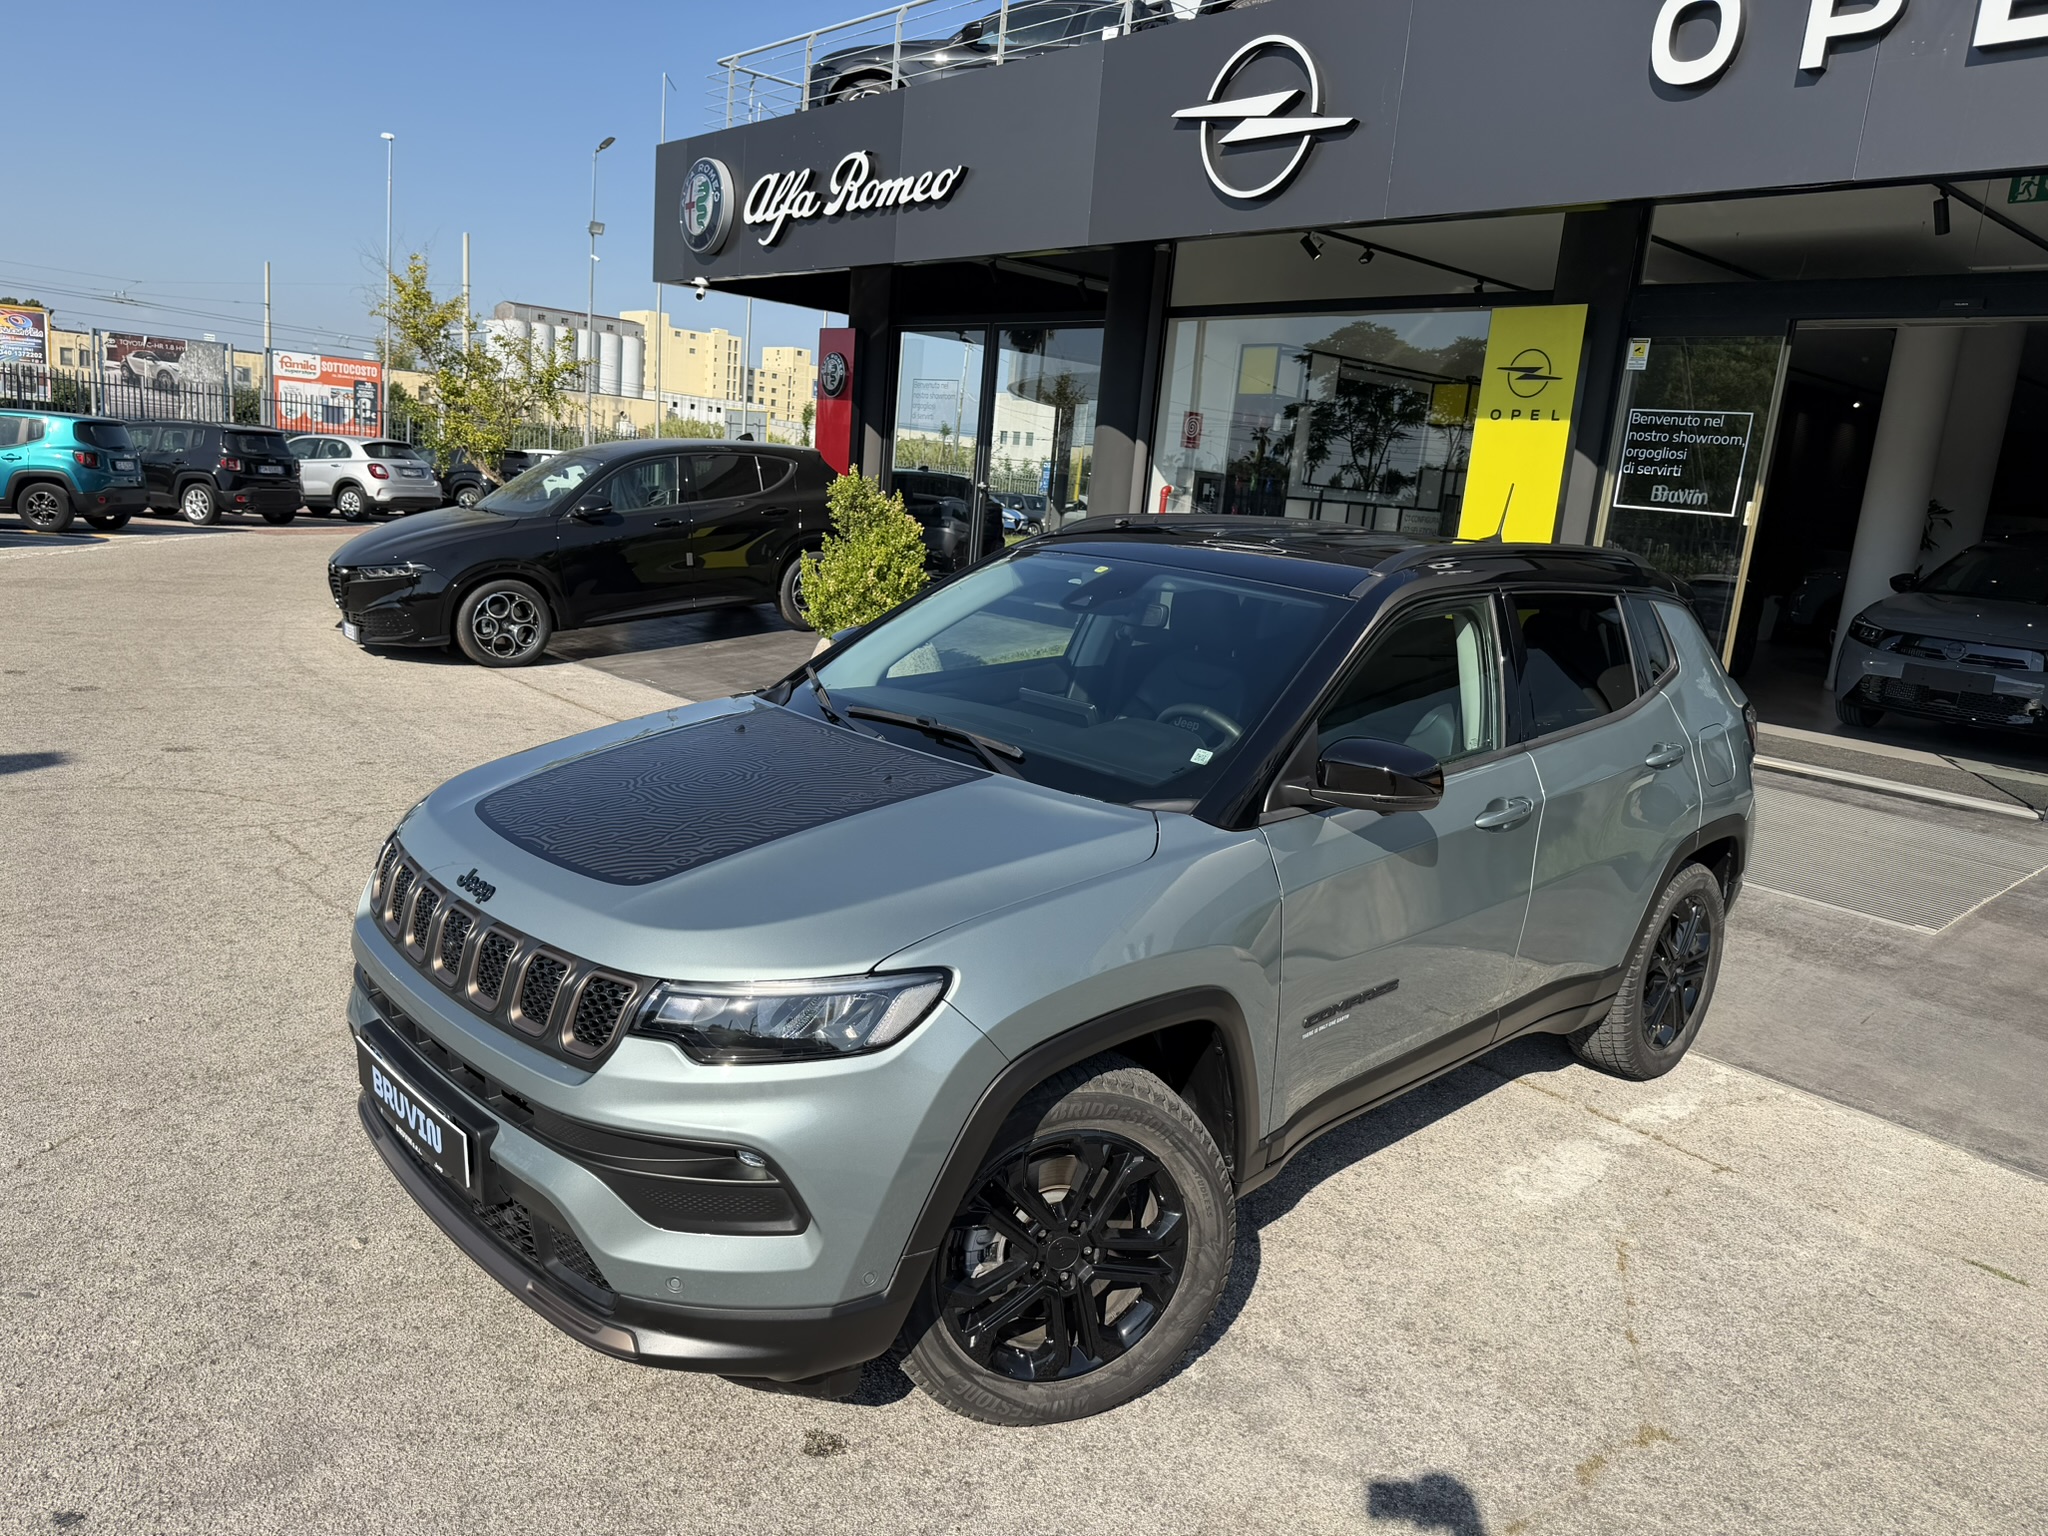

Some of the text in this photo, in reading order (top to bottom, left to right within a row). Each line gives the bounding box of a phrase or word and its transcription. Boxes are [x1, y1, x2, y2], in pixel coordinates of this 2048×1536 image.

[698, 163, 721, 202] ROMEO
[743, 150, 963, 246] Alfa Romeo
[146, 341, 164, 350] C-HR
[14, 350, 43, 359] 1372202
[278, 355, 317, 371] famila
[321, 361, 378, 377] SOTTOCOSTO
[284, 368, 317, 376] superstore
[1490, 409, 1560, 421] OPEL
[1631, 412, 1725, 428] Benvenuto nel
[1628, 430, 1746, 448] nostro showroom,
[1625, 446, 1688, 462] orgogliosi
[1622, 461, 1683, 477] di servirti
[1173, 716, 1200, 732] Jeep
[456, 867, 497, 905] Jeep
[371, 1064, 443, 1155] BRUVIN
[1050, 1100, 1182, 1147] BRIDGESTONE
[1191, 1168, 1214, 1219] STUDLESS
[952, 1380, 1090, 1420] BRIDGESTONE
